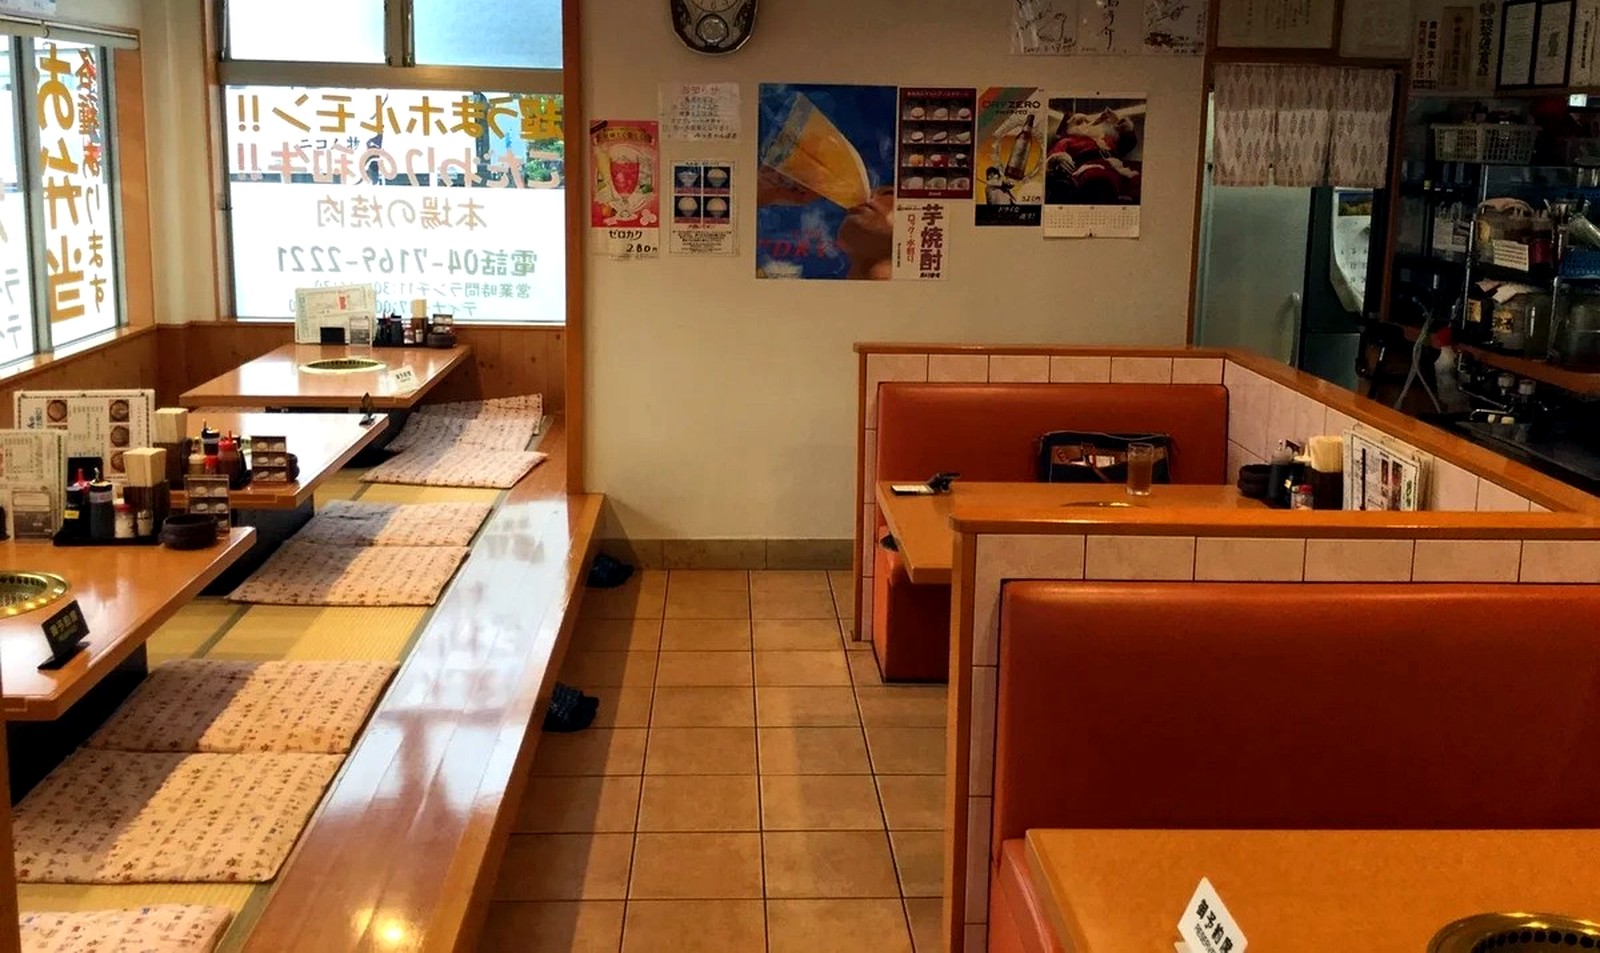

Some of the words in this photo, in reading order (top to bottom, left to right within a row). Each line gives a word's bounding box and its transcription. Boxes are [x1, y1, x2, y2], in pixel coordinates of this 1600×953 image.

[1008, 100, 1041, 109] ZERO
[608, 229, 643, 241] ゼロカク
[920, 203, 944, 271] 芋焼酎
